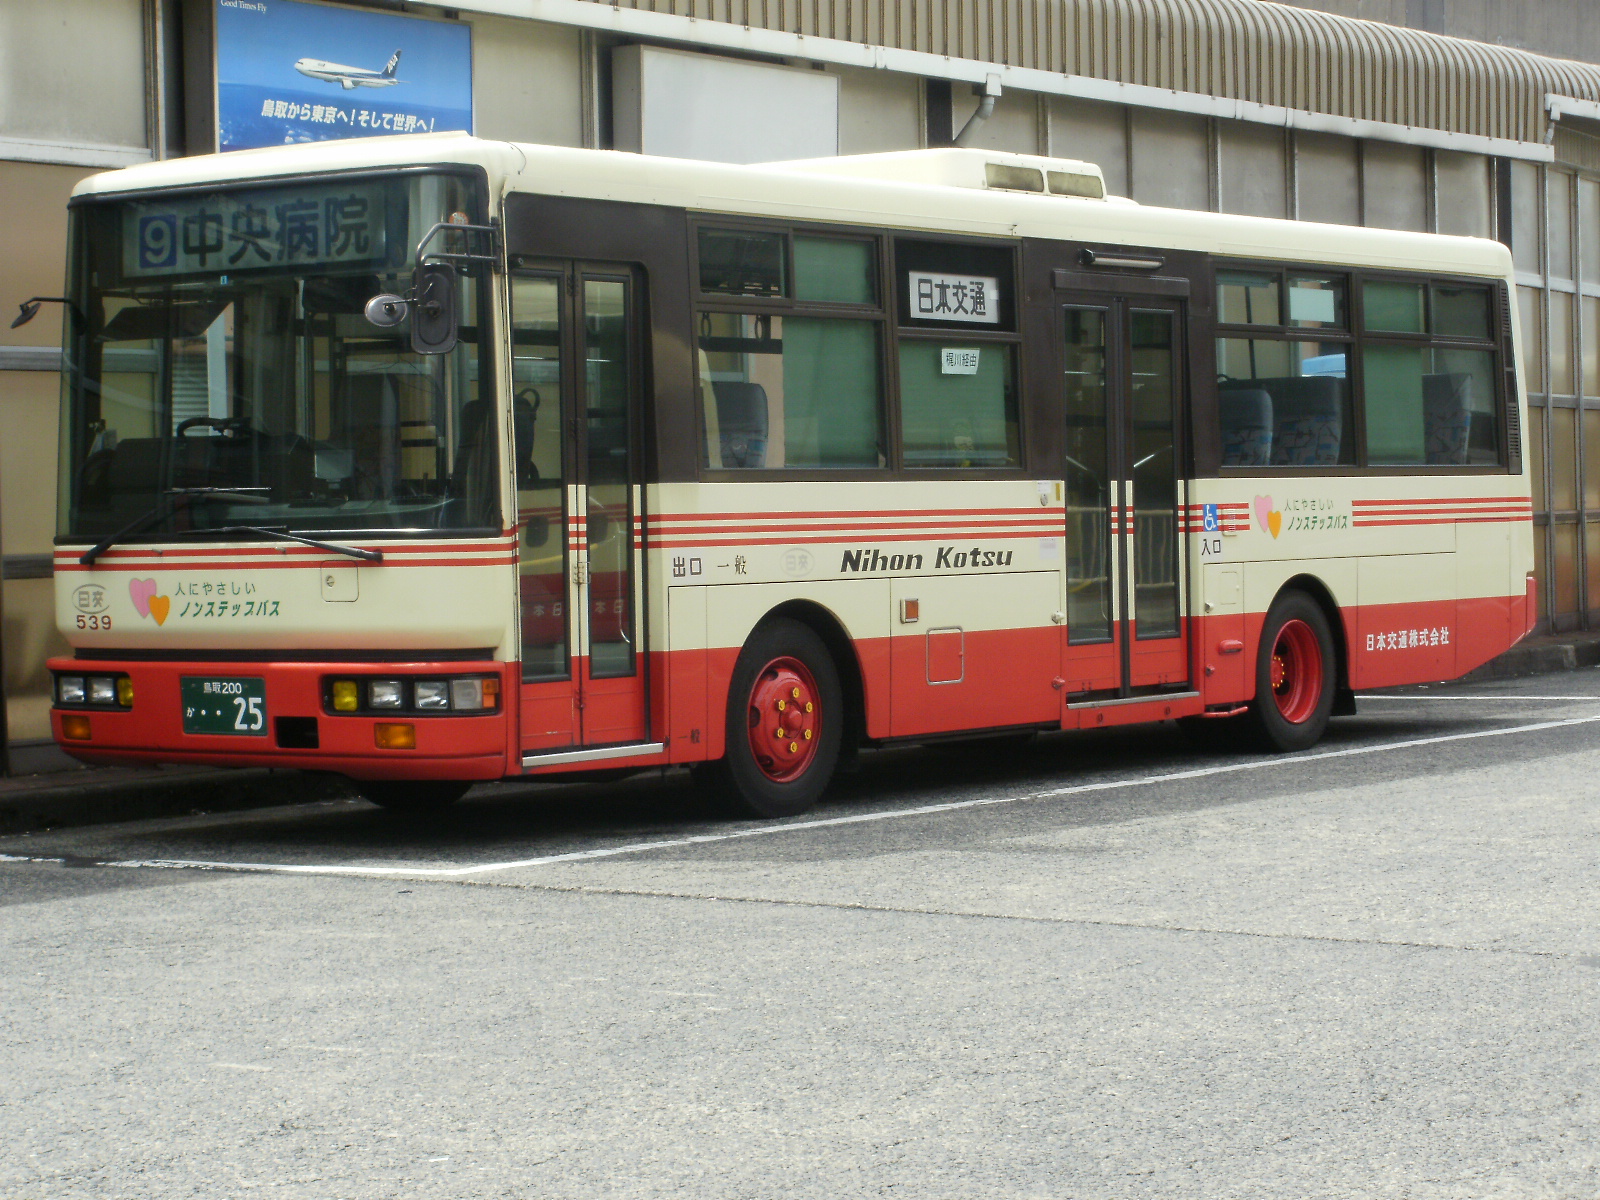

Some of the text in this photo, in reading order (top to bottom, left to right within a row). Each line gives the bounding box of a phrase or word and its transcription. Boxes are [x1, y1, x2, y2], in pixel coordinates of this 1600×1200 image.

[220, 0, 267, 14] Good Times Fly
[144, 196, 370, 267] 9 中央病院
[917, 277, 986, 316] 日本交通
[1284, 498, 1334, 511] 人にやさしい
[1287, 515, 1348, 531] ノンステップバス
[1201, 538, 1221, 556] 入口
[673, 554, 747, 578] 出口 一般
[840, 548, 923, 574] Nihon
[934, 545, 1013, 569] Kotsu
[174, 581, 257, 596] 人にやさしい
[179, 600, 281, 618] ノンステップバス
[76, 614, 112, 631] 539
[1365, 626, 1450, 651] 日本交通株式会社
